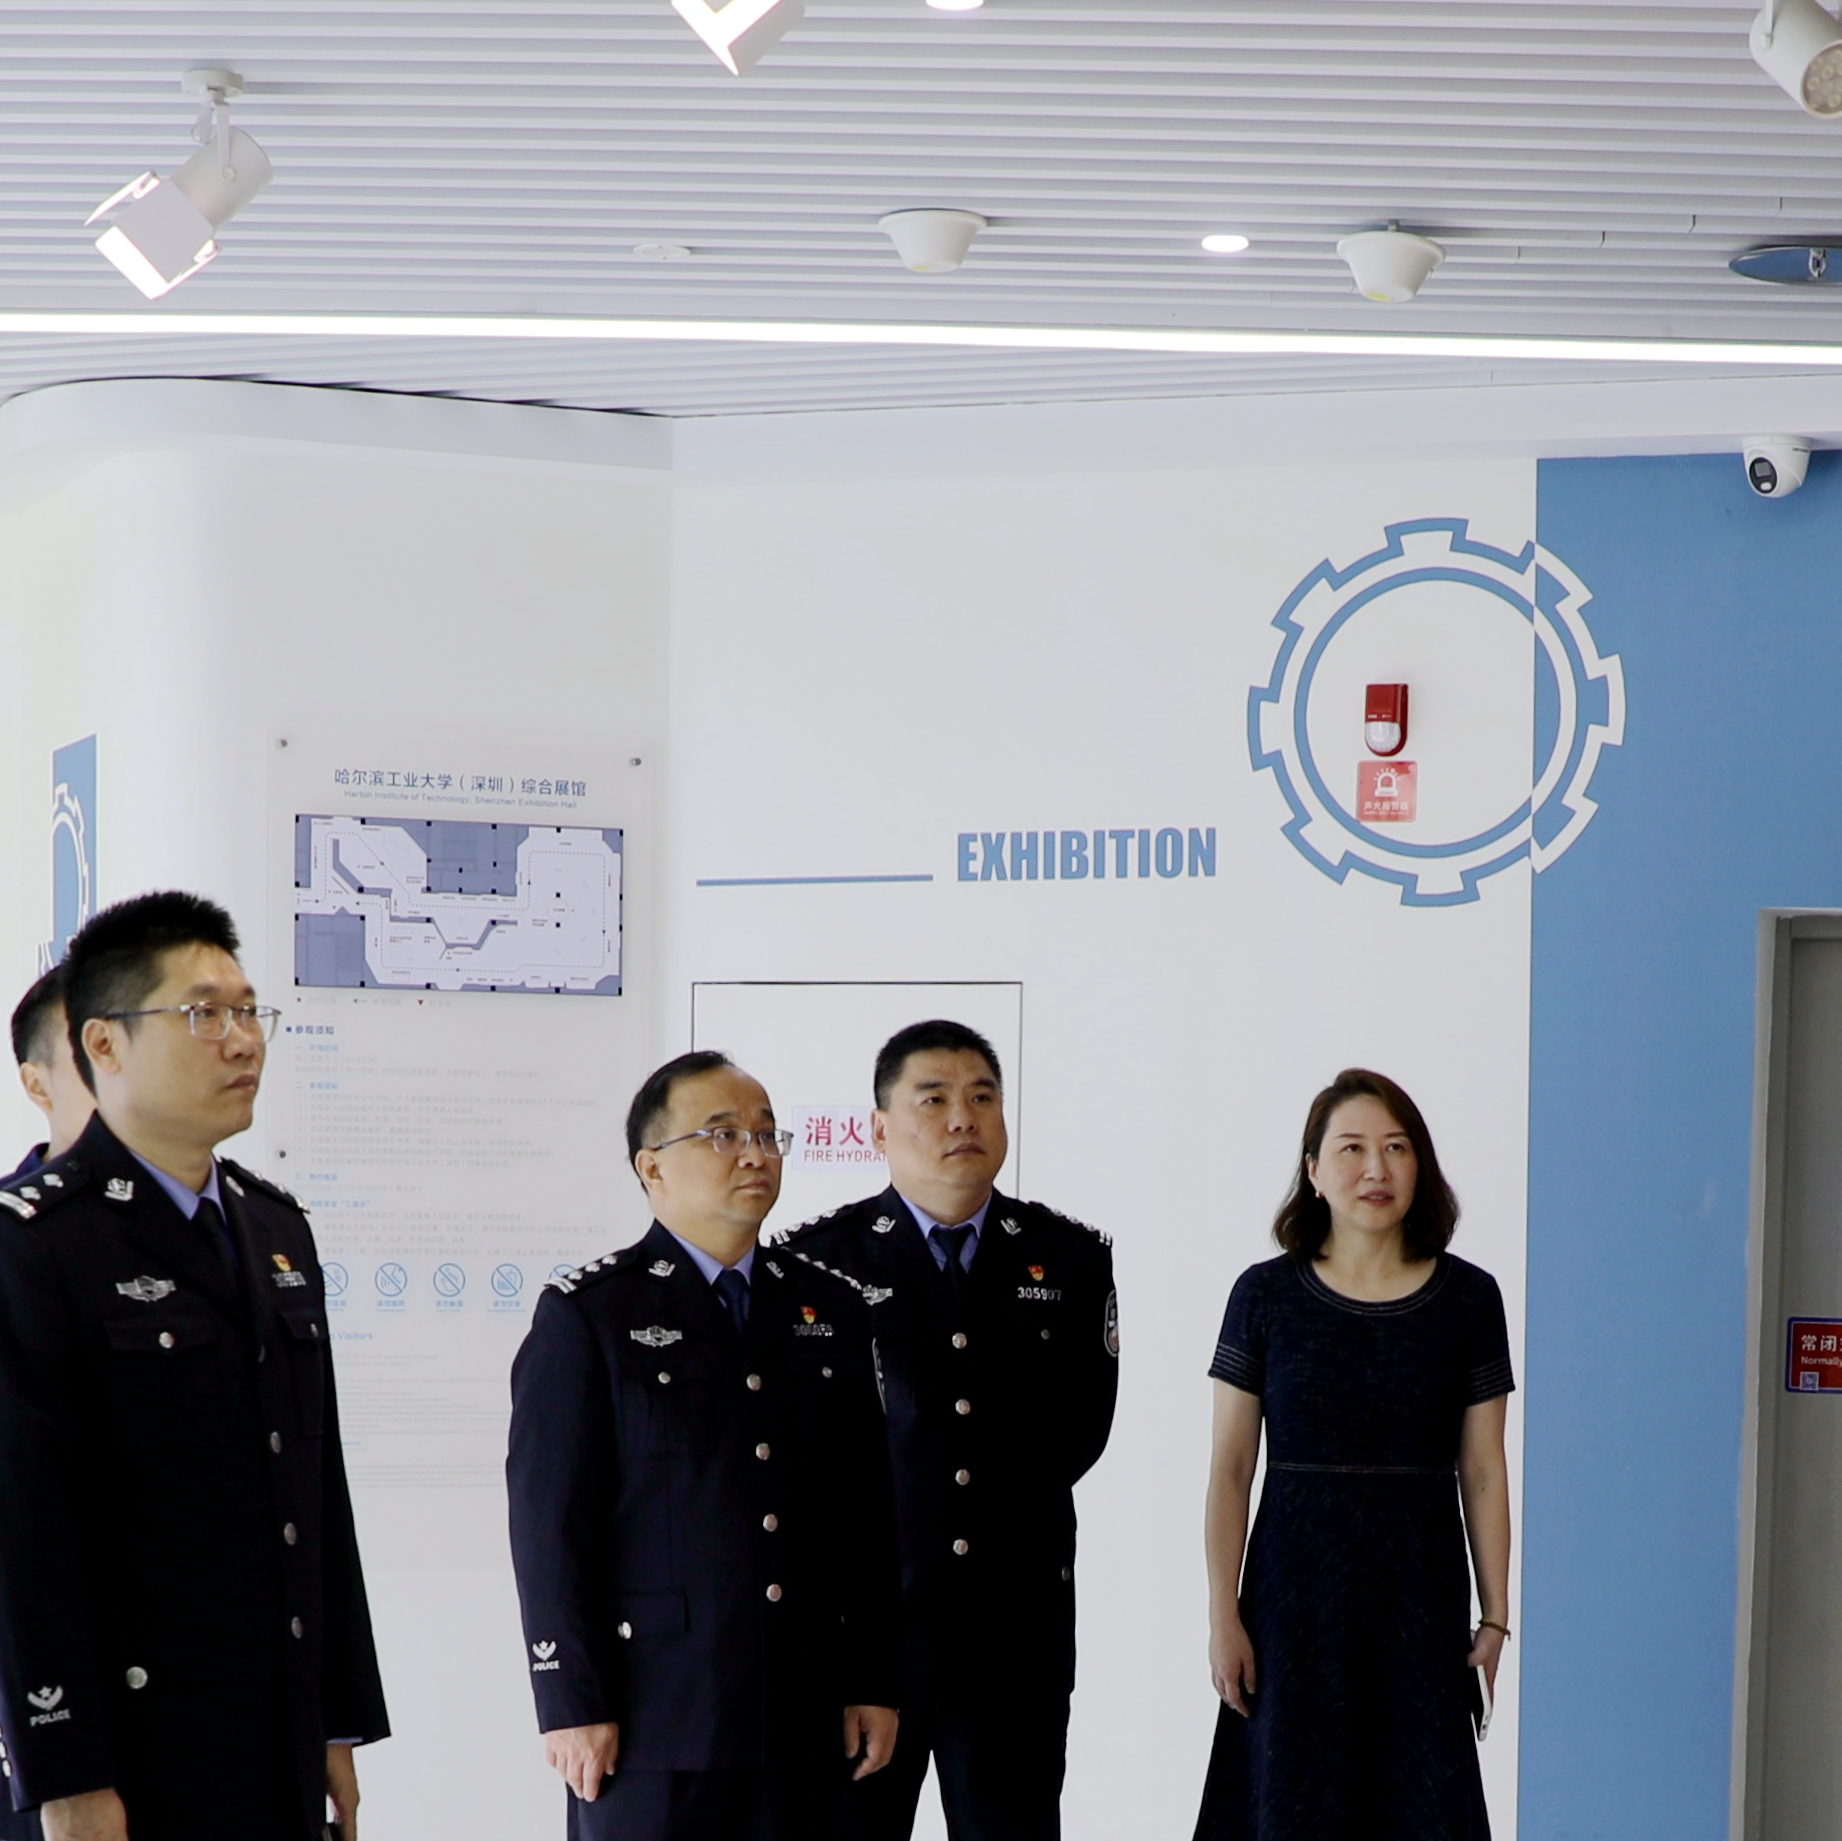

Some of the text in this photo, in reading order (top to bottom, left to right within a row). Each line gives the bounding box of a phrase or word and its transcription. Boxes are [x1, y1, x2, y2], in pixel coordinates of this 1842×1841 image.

[343, 789, 372, 799] Harbin
[374, 791, 409, 800] Institute
[410, 792, 419, 801] of
[474, 796, 517, 806] Shenzhen
[518, 798, 559, 808] Exhibition
[560, 800, 578, 809] Hall
[957, 827, 1217, 882] EXHIBITION
[804, 1115, 865, 1146] 消火
[804, 1150, 834, 1162] FIRE
[1017, 1286, 1062, 1301] 305907
[337, 1330, 373, 1341] Visitors
[533, 1660, 560, 1672] POLICE
[29, 1709, 71, 1727] POLICE
